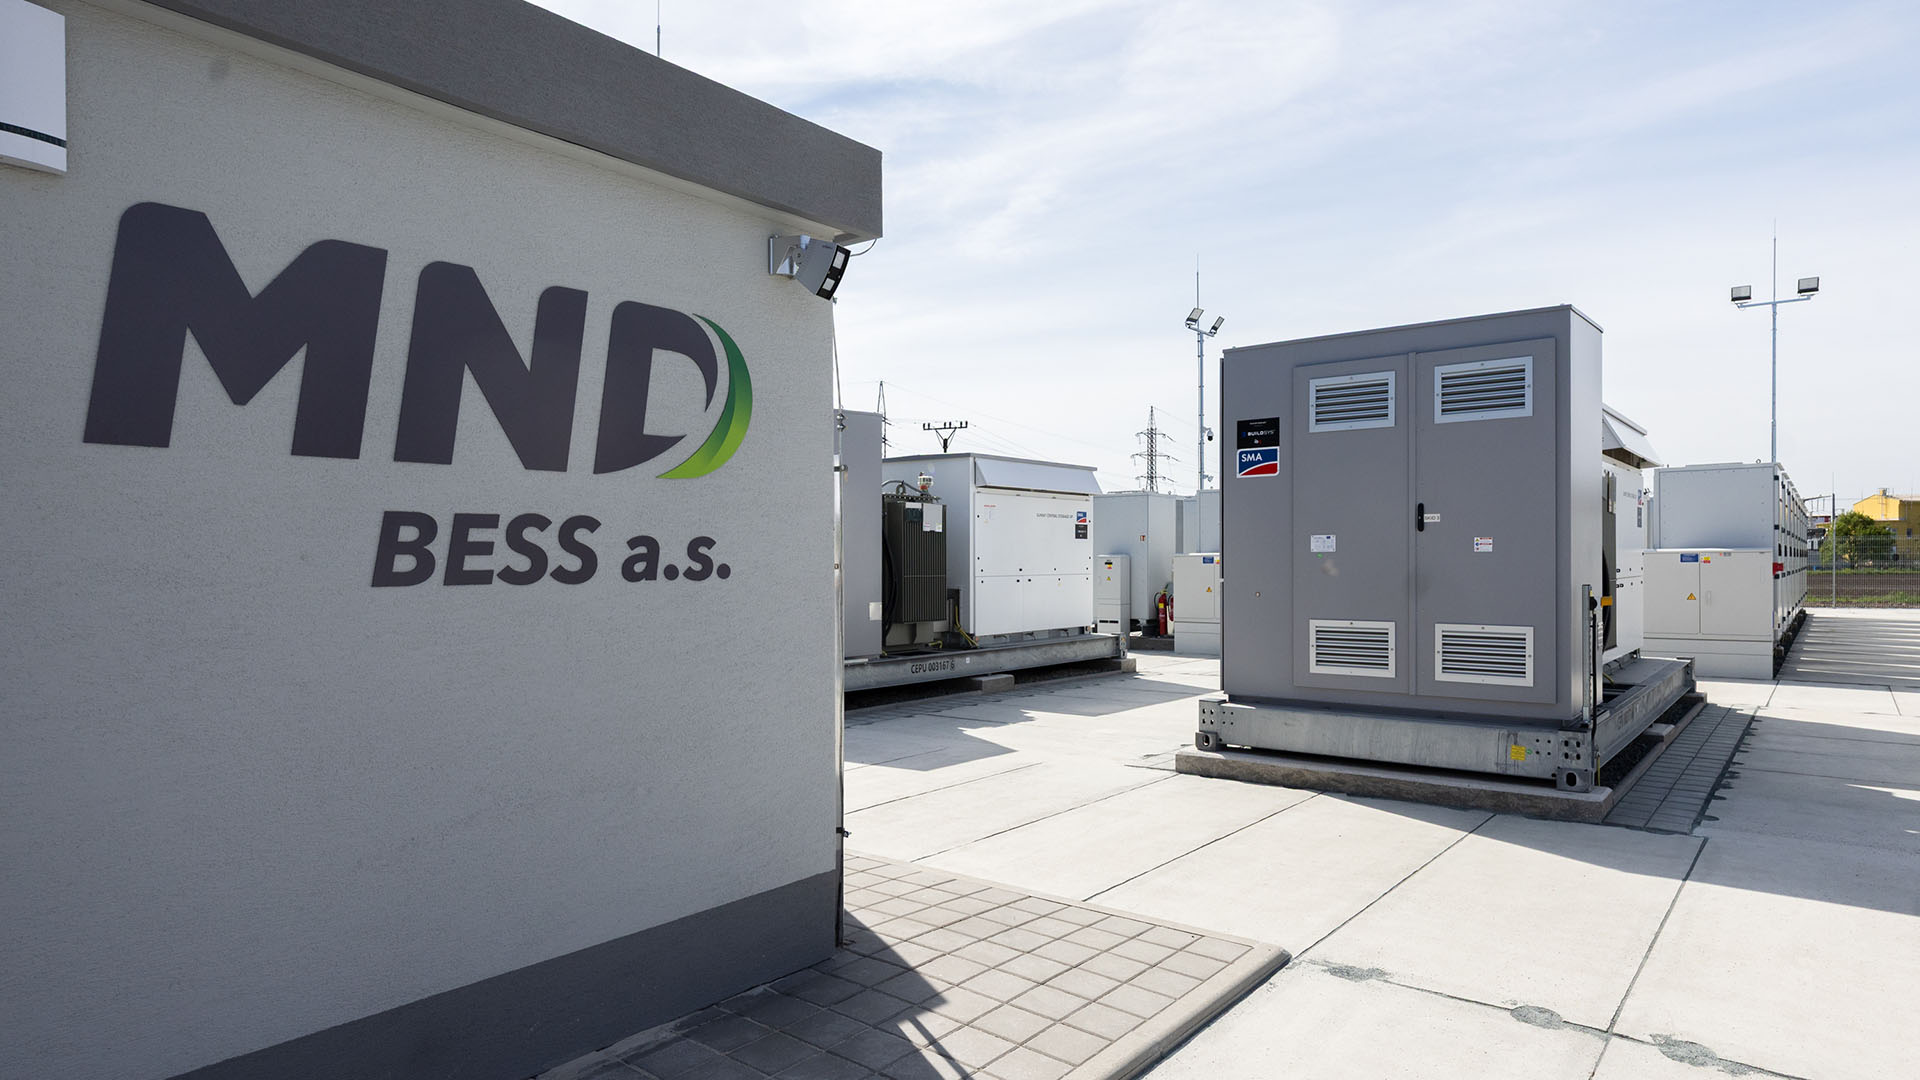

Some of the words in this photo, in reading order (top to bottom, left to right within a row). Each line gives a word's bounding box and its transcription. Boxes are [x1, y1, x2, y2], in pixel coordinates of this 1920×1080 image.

[82, 202, 753, 480] MND
[1241, 453, 1262, 462] SMA
[371, 511, 601, 587] BESS
[622, 535, 731, 583] a.s.
[911, 664, 927, 673] CEPU
